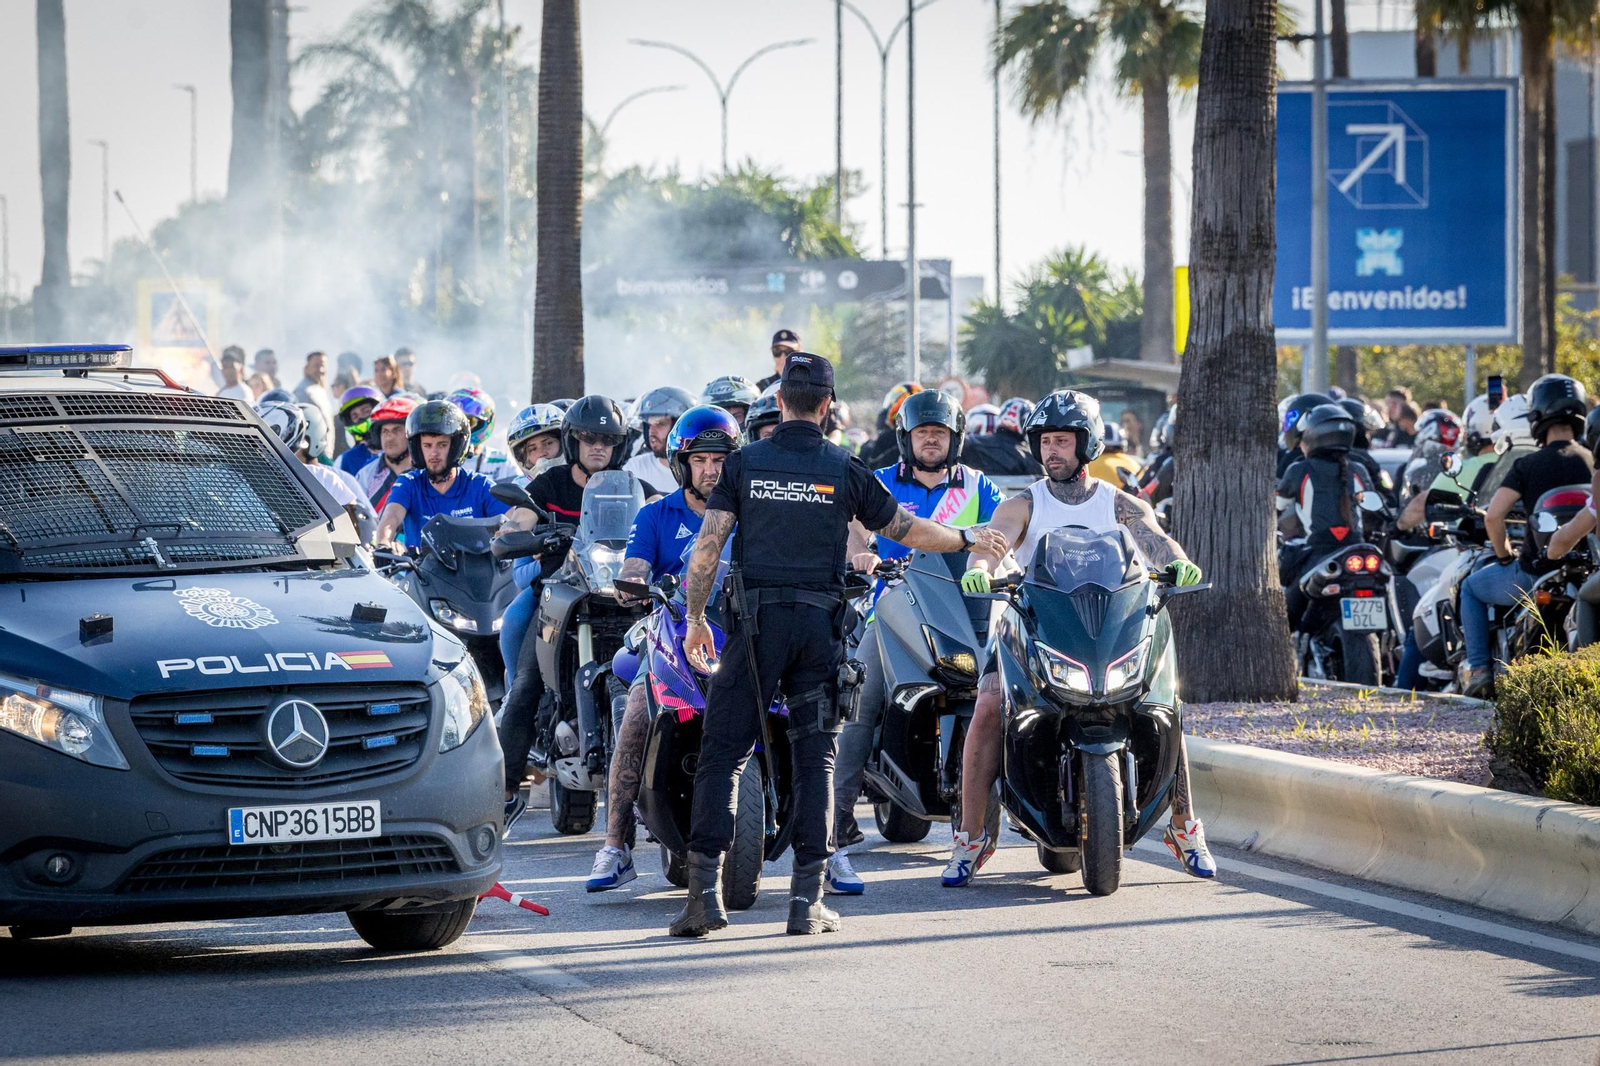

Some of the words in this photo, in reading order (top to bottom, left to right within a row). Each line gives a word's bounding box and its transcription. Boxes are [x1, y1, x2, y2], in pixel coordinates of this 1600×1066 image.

[1292, 285, 1467, 310] ¡Benvenidos!
[750, 479, 817, 493] POLICIA
[750, 489, 834, 504] NACIONAL
[1351, 600, 1383, 613] 2779
[1352, 614, 1377, 627] DZL
[234, 829, 241, 838] E
[244, 806, 375, 838] CNP3615BB
